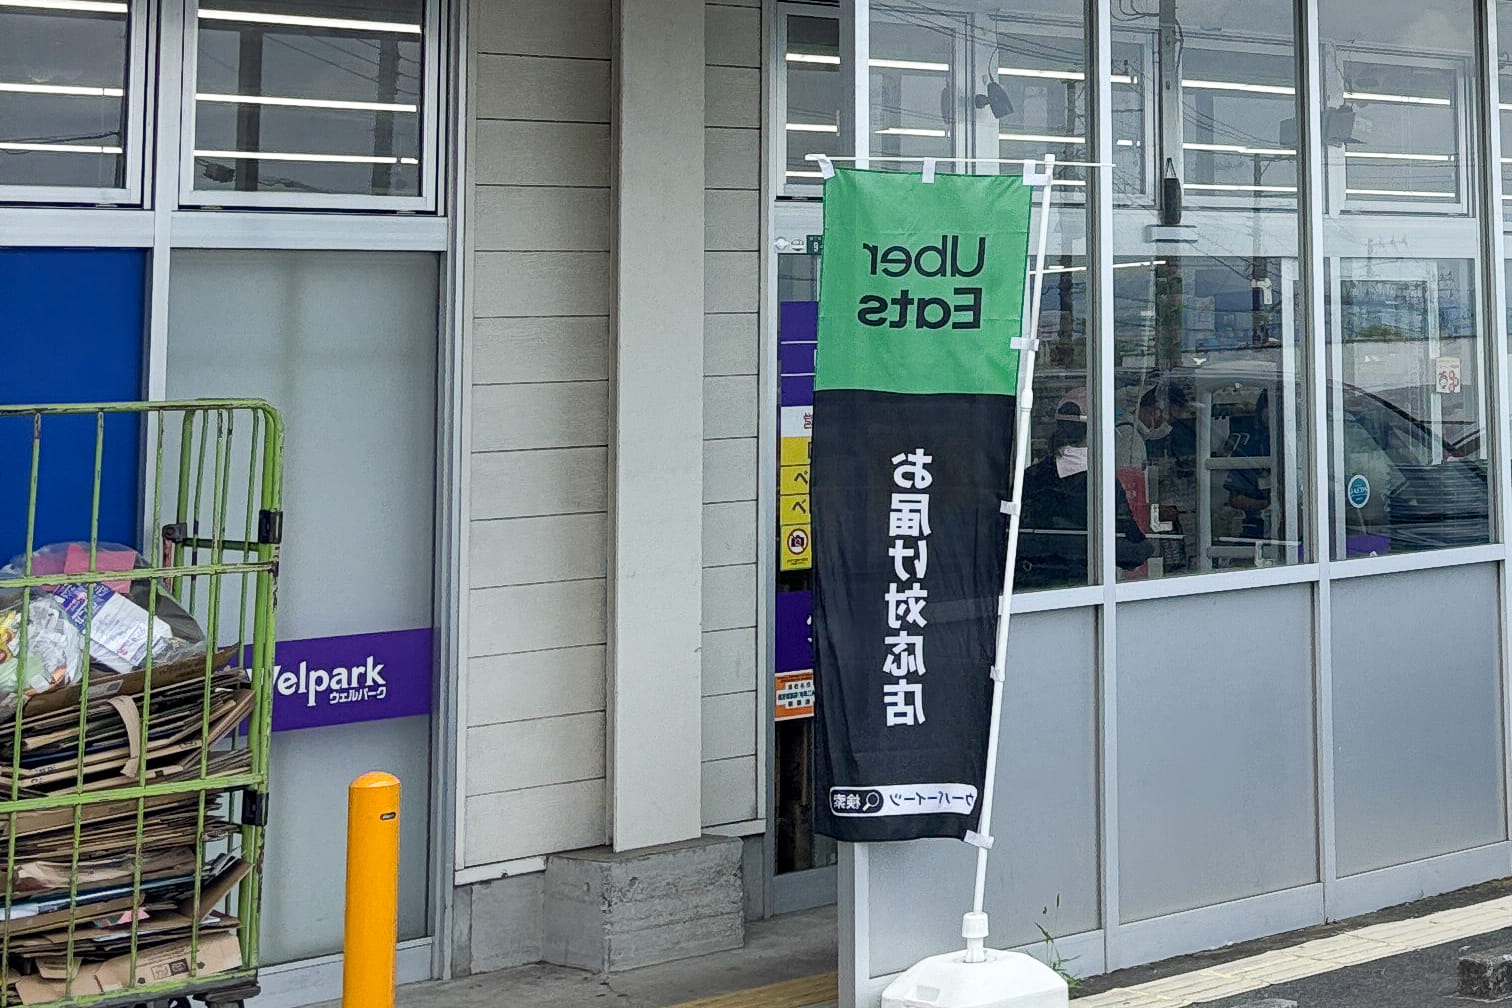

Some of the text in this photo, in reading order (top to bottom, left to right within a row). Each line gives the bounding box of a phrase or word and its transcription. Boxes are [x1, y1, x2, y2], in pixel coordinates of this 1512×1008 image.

[329, 686, 387, 705] ウェルパーク
